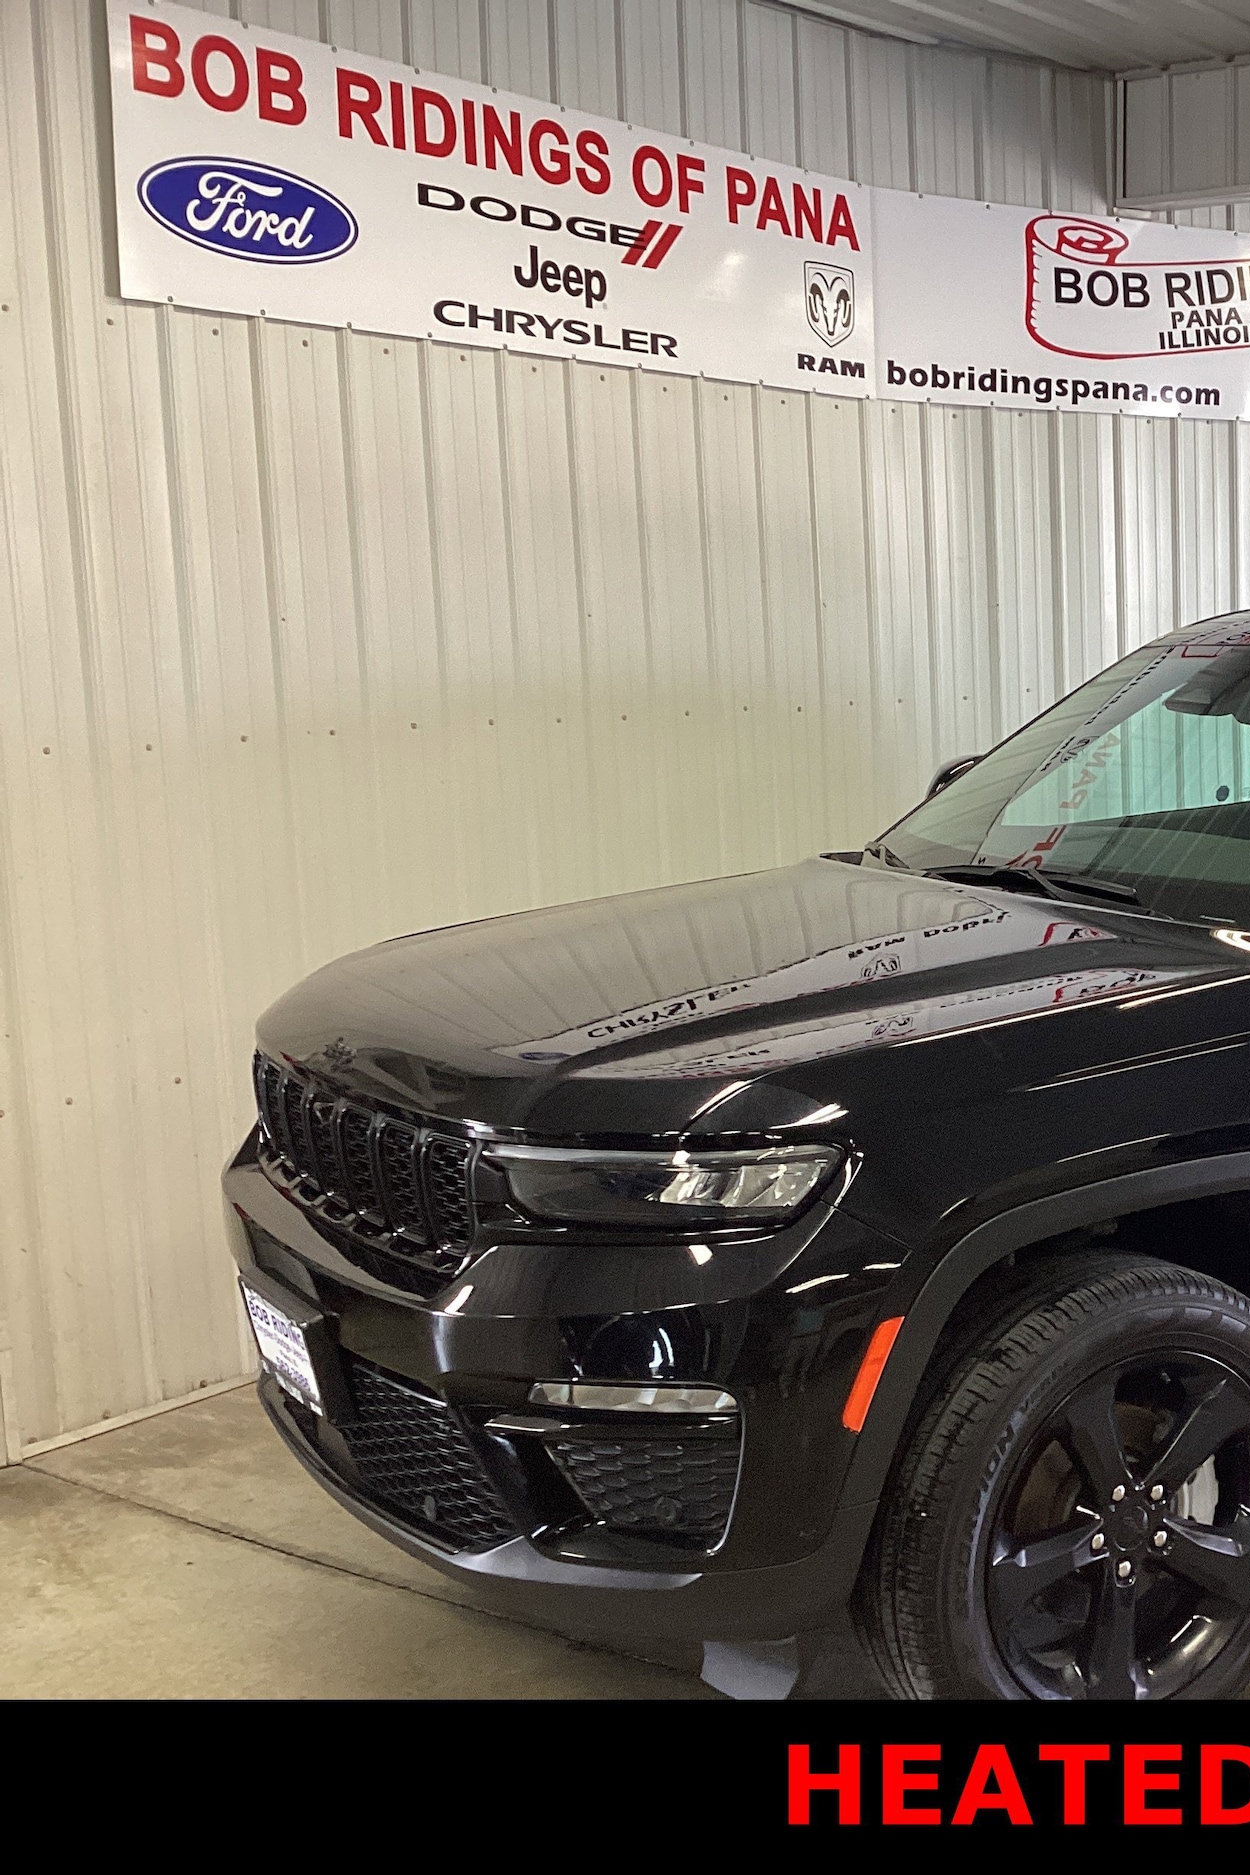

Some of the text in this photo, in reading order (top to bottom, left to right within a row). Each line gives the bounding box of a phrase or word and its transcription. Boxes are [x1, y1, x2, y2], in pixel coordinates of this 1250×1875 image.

[129, 14, 861, 252] BOB RIDINGS OF PANA
[185, 170, 316, 250] Ford
[417, 182, 648, 251] DODGE
[514, 245, 607, 309] Jeep
[1054, 267, 1150, 309] BOB
[433, 300, 679, 358] CHRYSLER
[1171, 308, 1243, 329] PANA
[797, 353, 866, 379] RAM
[886, 359, 1221, 407] bobridingspana.com
